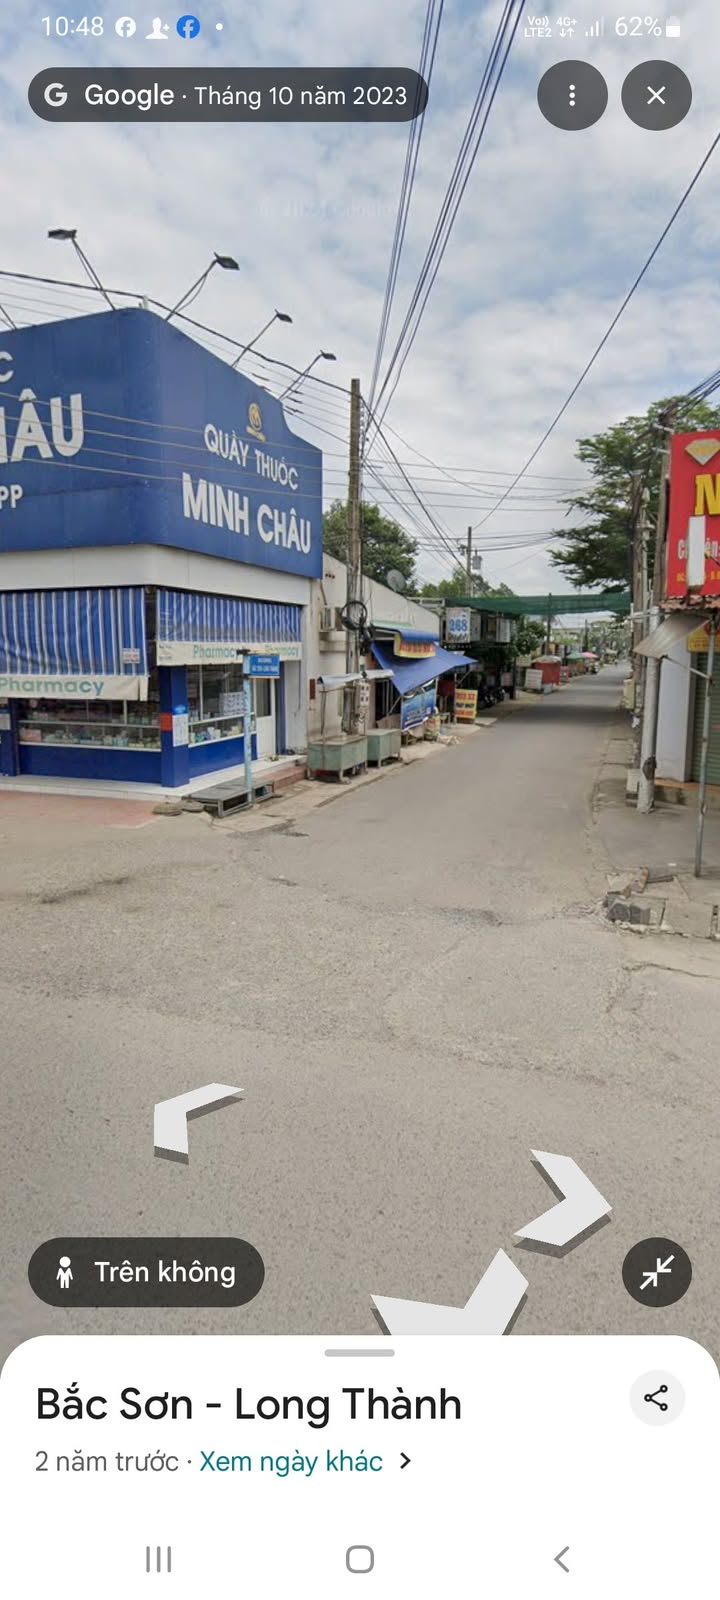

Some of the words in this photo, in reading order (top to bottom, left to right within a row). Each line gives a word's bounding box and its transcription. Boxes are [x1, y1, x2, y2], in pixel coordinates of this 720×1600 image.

[254, 448, 299, 491] THUỐC
[182, 472, 250, 536] MINH
[257, 504, 312, 554] CHÂU
